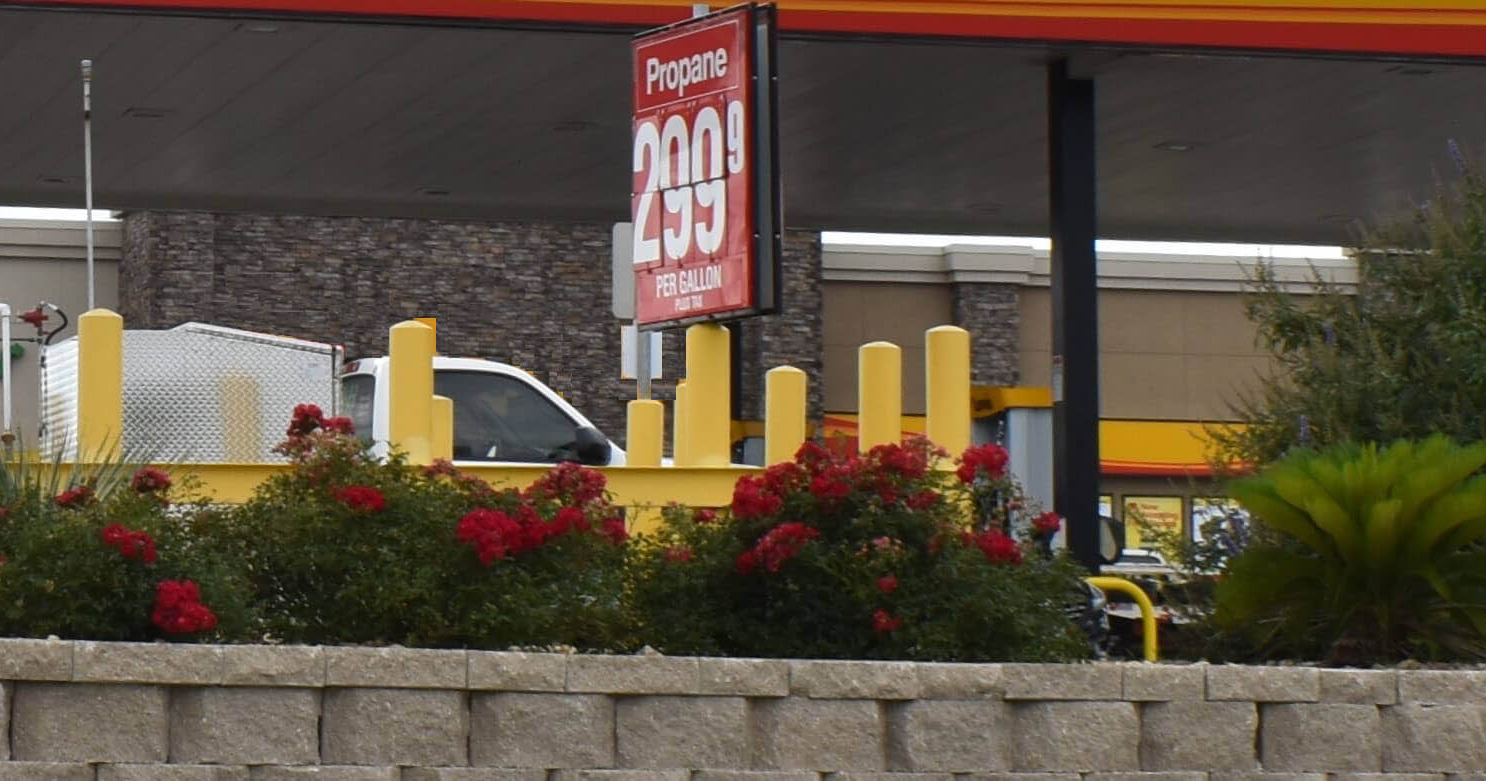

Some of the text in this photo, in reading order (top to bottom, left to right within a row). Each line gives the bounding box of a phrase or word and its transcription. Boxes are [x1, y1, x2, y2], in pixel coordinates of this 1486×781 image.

[646, 47, 727, 97] Propane
[655, 265, 722, 298] PER GALLON
